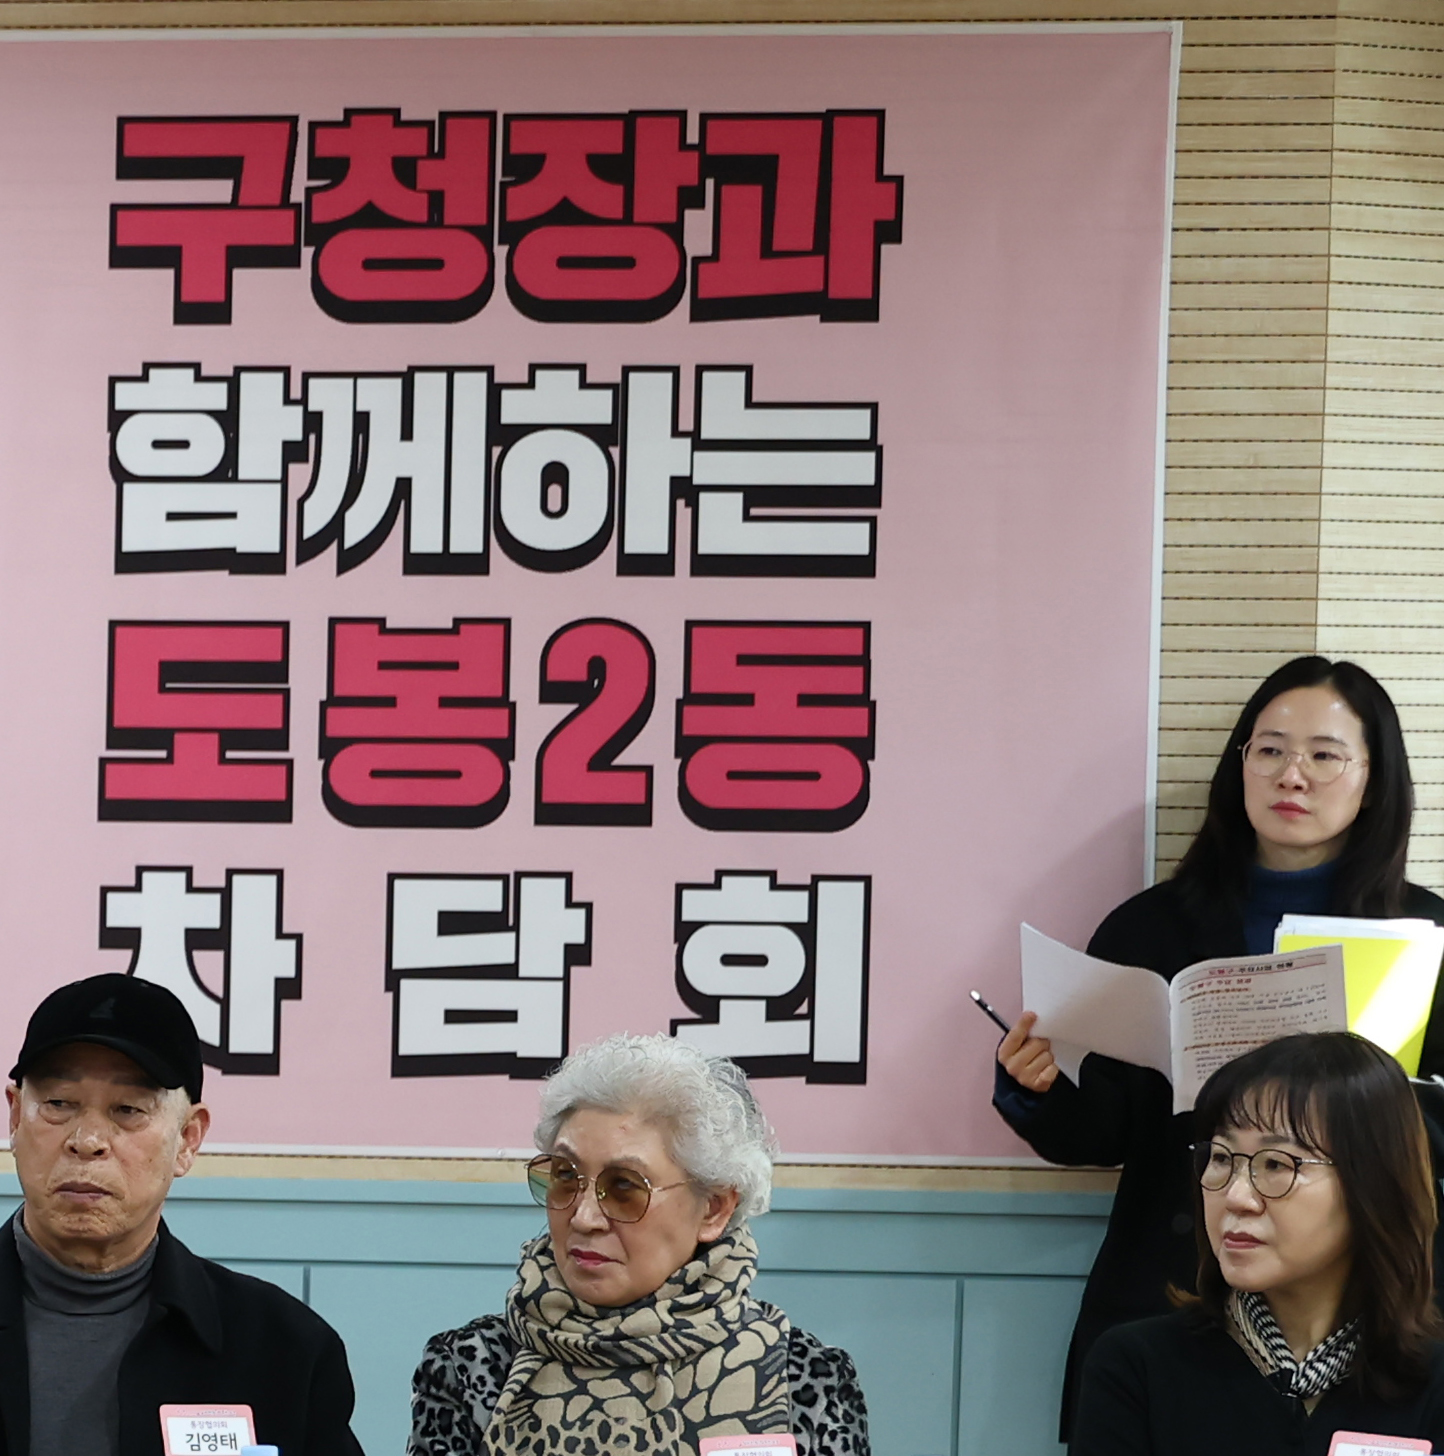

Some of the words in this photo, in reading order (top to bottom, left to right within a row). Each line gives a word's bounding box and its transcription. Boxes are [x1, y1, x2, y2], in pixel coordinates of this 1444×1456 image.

[109, 108, 904, 325] 구청장과
[108, 362, 883, 577] 함께하는
[98, 616, 876, 832] 도봉2동
[185, 1432, 238, 1453] 김영태
